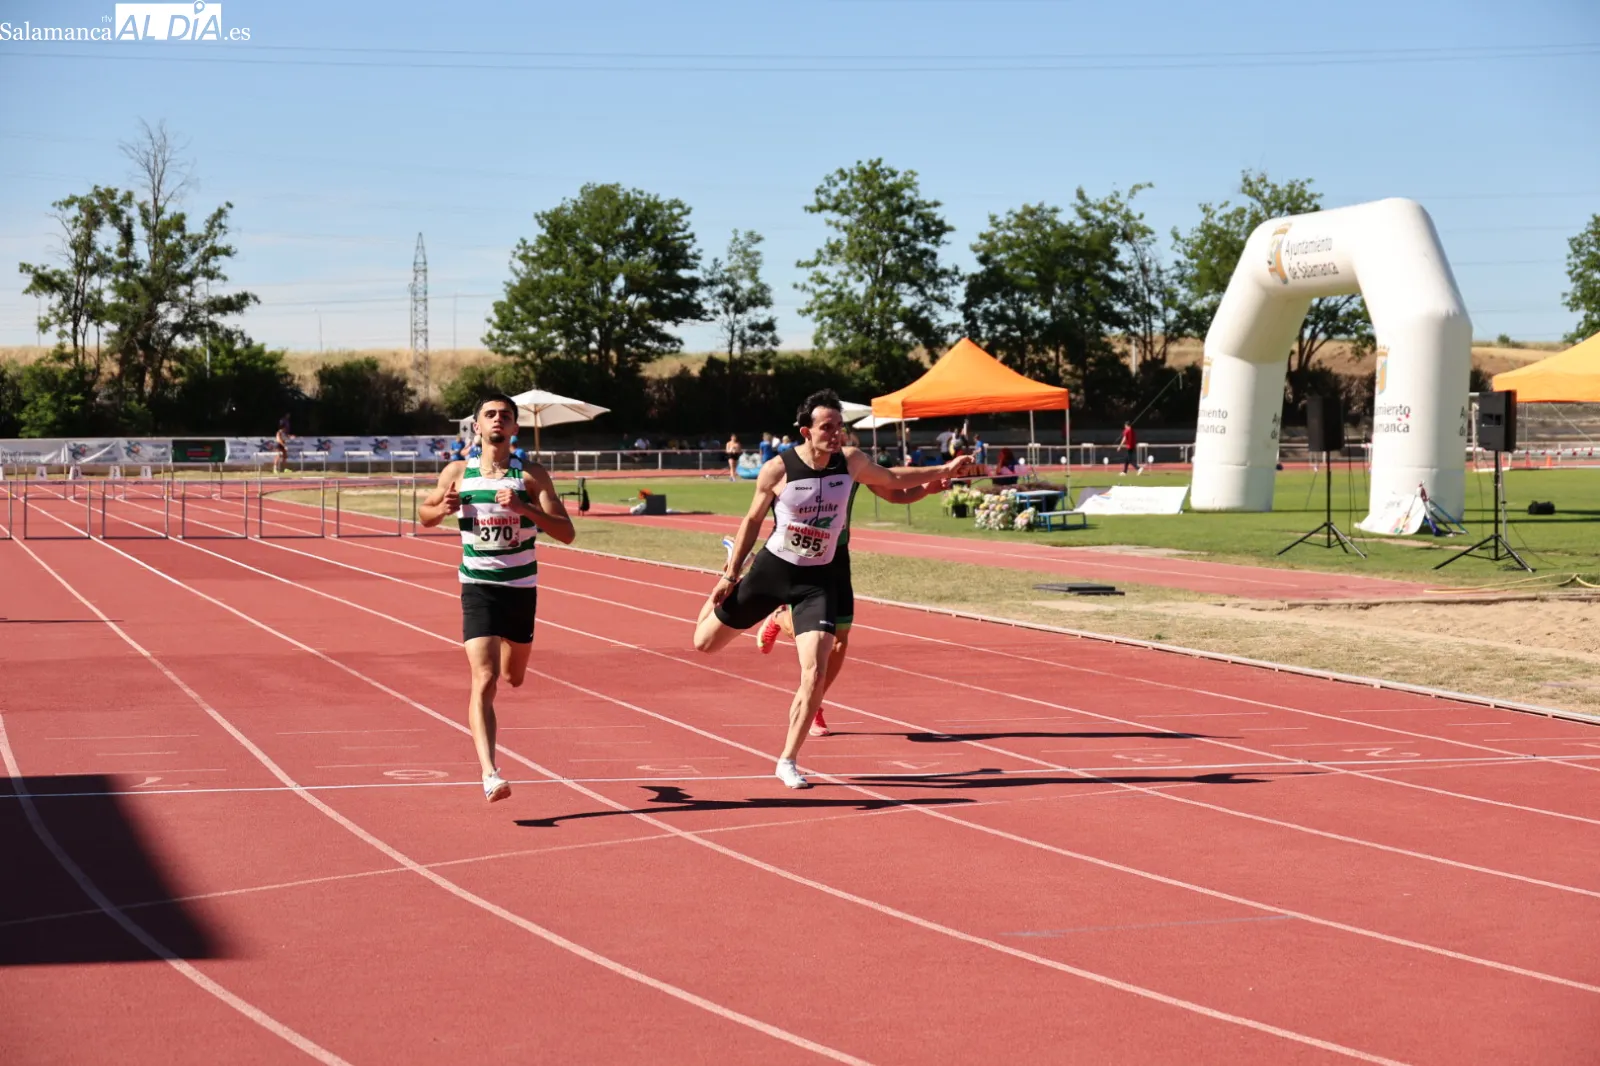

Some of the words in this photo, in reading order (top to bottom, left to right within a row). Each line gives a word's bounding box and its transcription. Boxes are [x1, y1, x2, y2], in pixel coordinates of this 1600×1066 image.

[1284, 236, 1333, 260] Ayuntamiento
[1288, 261, 1300, 279] de
[1297, 259, 1340, 279] Salamanca
[480, 526, 513, 542] 370
[791, 533, 823, 552] 355
